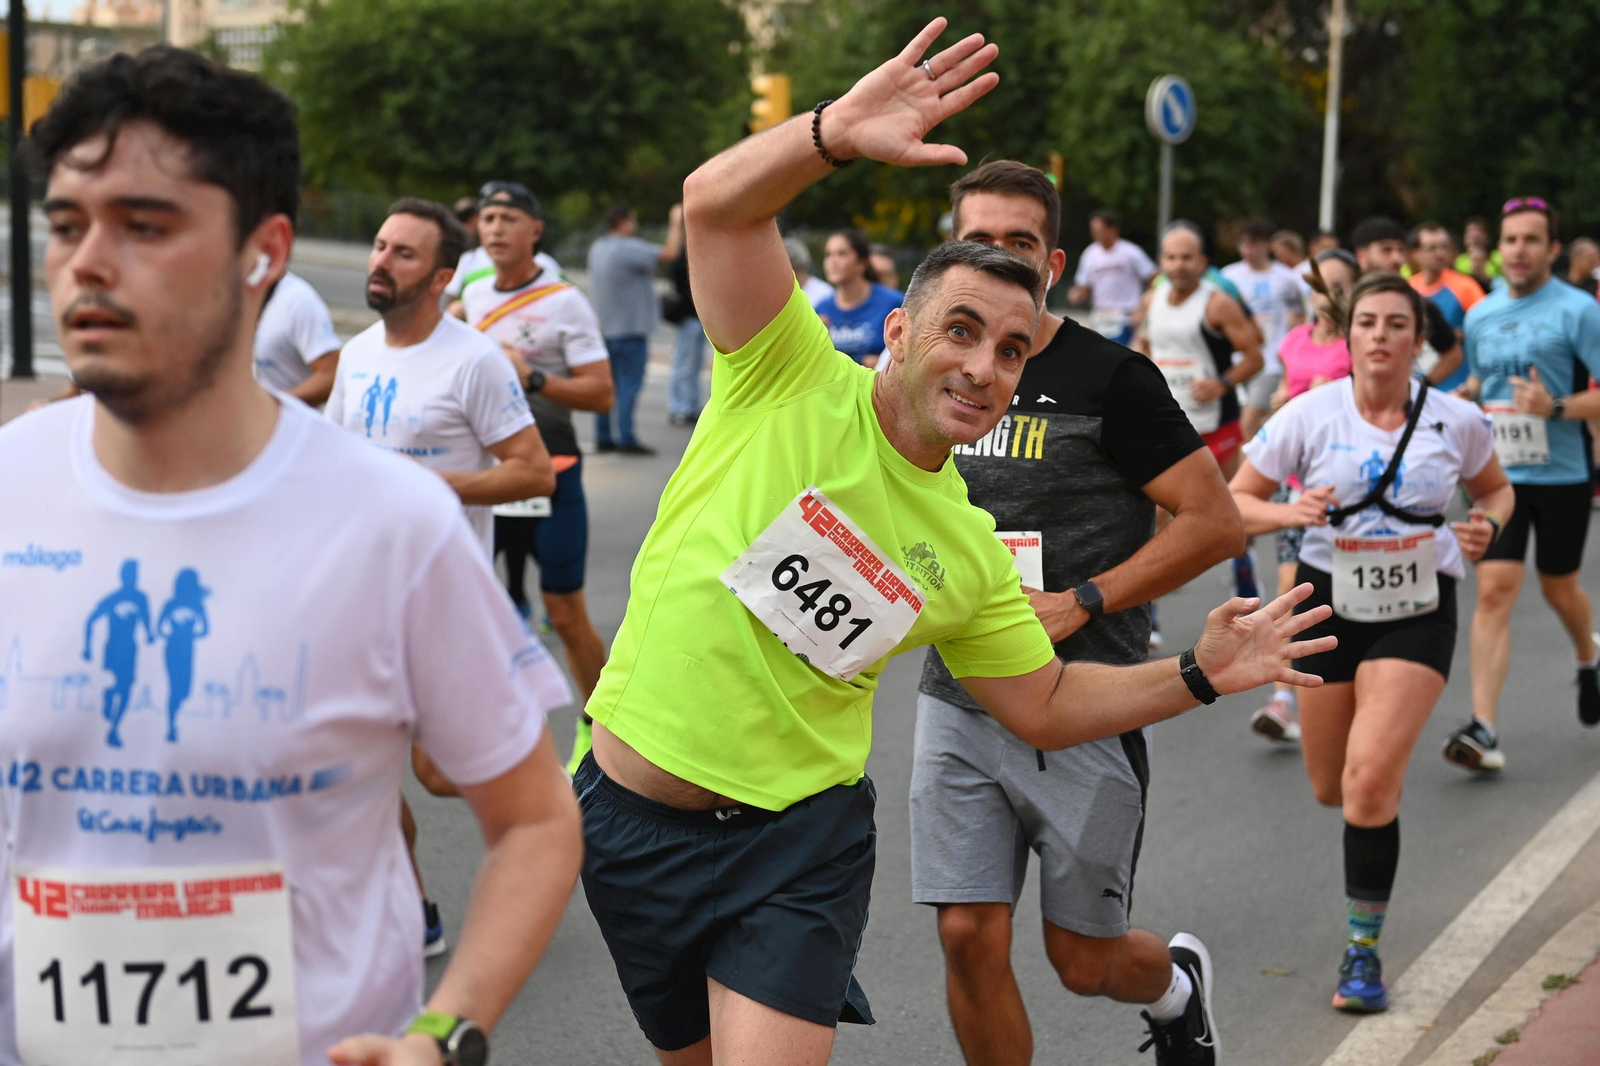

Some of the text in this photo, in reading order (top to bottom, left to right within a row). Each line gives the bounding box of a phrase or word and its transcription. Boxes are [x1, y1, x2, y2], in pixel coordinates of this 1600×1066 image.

[798, 493, 923, 614] 42 CARRERA URBANA
[827, 530, 854, 558] CIUDAD
[852, 558, 900, 604] MALAGA
[1000, 537, 1039, 547] RBANA
[771, 553, 874, 651] 6481
[1352, 561, 1418, 590] 1351
[51, 766, 184, 797] CARRERA
[191, 773, 301, 802] URBANA
[18, 876, 69, 920] 42
[39, 953, 274, 1026] 11712
